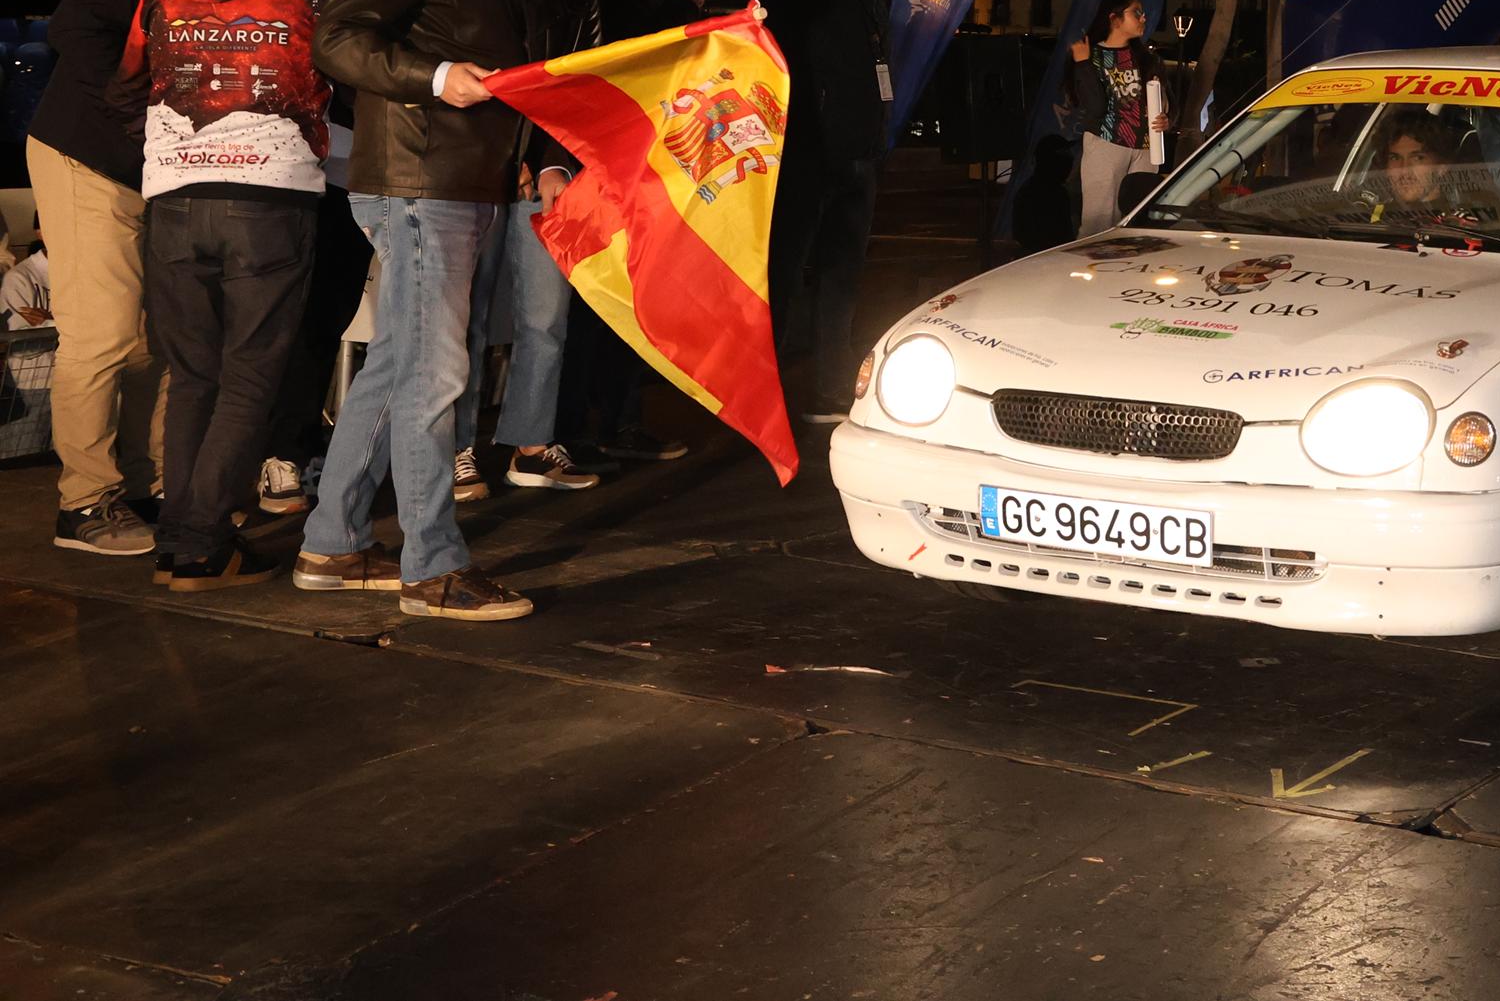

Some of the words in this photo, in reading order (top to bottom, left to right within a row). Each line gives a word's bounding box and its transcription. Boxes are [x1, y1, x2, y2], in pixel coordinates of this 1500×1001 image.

[169, 29, 288, 45] LANZAROTE
[1110, 288, 1175, 305] 928
[1172, 295, 1237, 314] 591
[1249, 302, 1320, 317] 046
[1173, 319, 1200, 328] CASA
